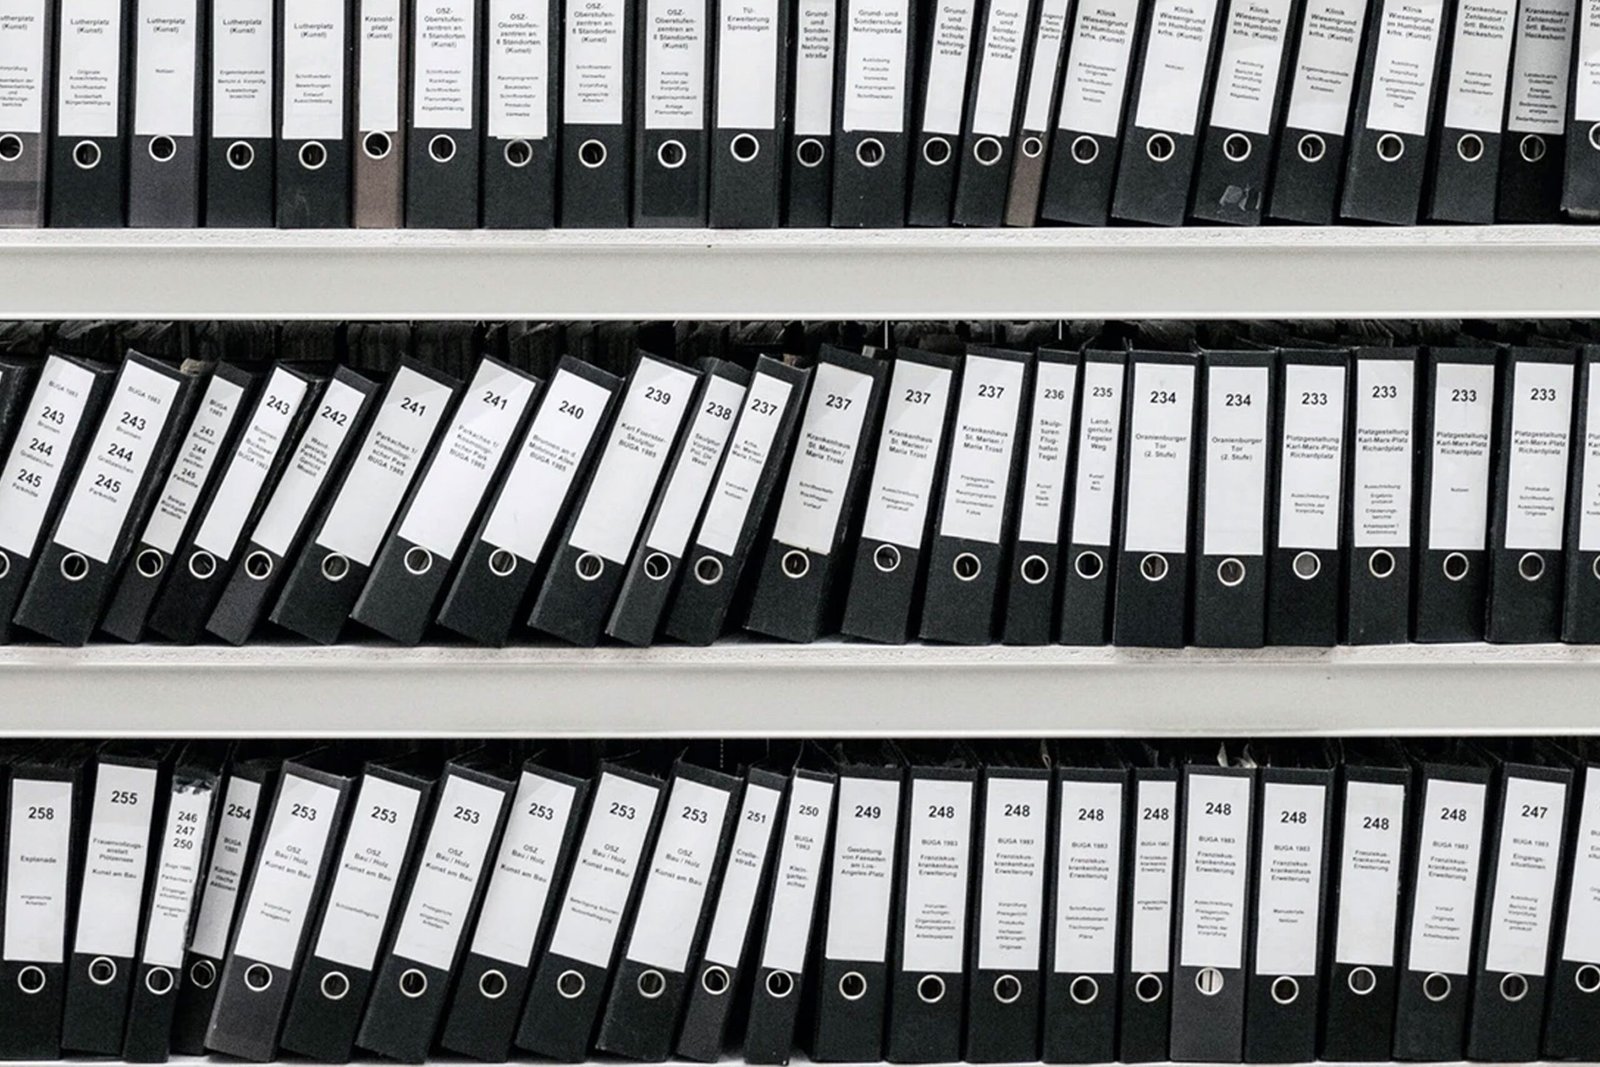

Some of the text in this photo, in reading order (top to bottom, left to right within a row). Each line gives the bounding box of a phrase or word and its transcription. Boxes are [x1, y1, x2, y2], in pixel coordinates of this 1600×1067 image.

[1249, 6, 1269, 14] Klinik
[1464, 4, 1508, 15] Krankenhaus
[854, 18, 902, 26] Sonderschule
[1464, 12, 1501, 22] Zehlendorf
[727, 24, 769, 32] Spreebogen
[1479, 22, 1505, 31] Bereich
[1463, 30, 1503, 39] Heckeshorn
[644, 386, 671, 405] 239
[905, 389, 931, 404] 237
[978, 384, 1004, 399] 237
[1044, 388, 1064, 400] 236
[1093, 386, 1113, 398] 235
[1150, 390, 1176, 404] 234
[1372, 385, 1397, 398] 233
[1451, 389, 1477, 402] 233
[1530, 388, 1556, 402] 233
[266, 395, 290, 415] 243
[400, 396, 426, 416] 241
[482, 390, 508, 410] 241
[826, 394, 852, 411] 237
[1225, 393, 1252, 407] 234
[1302, 392, 1328, 406] 233
[558, 400, 584, 420] 240
[706, 401, 732, 421] 238
[751, 398, 778, 417] 237
[41, 406, 65, 425] 243
[120, 411, 146, 431] 243
[321, 406, 348, 427] 242
[200, 426, 214, 437] 243
[962, 425, 1008, 437] Krankenhaus
[1135, 433, 1187, 443] Oranienburger
[29, 438, 53, 457] 244
[107, 443, 134, 462] 244
[192, 444, 207, 456] 244
[964, 442, 982, 450] Maria
[1290, 452, 1334, 460] Richardplatz
[17, 468, 42, 488] 245
[181, 468, 196, 479] 245
[94, 474, 122, 493] 245
[110, 790, 138, 805] 255
[28, 806, 54, 820] 258
[226, 803, 252, 821] 254
[291, 803, 317, 821] 253
[371, 806, 397, 824] 253
[453, 806, 480, 824] 253
[528, 802, 554, 820] 253
[609, 802, 636, 820] 253
[682, 806, 708, 824] 253
[798, 804, 819, 817] 250
[854, 805, 881, 820] 249
[928, 805, 954, 819] 248
[1004, 804, 1030, 818] 248
[1078, 808, 1104, 822] 248
[1142, 807, 1169, 821] 248
[1205, 802, 1232, 816] 248
[1440, 807, 1467, 822] 248
[1521, 804, 1548, 819] 247
[178, 811, 198, 823] 246
[747, 810, 766, 824] 251
[1280, 810, 1307, 824] 248
[1363, 816, 1390, 830] 248
[176, 824, 195, 836] 247
[173, 838, 193, 850] 250
[847, 846, 882, 856] Gestaltung
[20, 855, 56, 863] Esplanade
[512, 849, 526, 859] Bau
[500, 864, 520, 874] Kunst
[533, 874, 547, 883] Bau
[918, 869, 957, 878] Erweiterung
